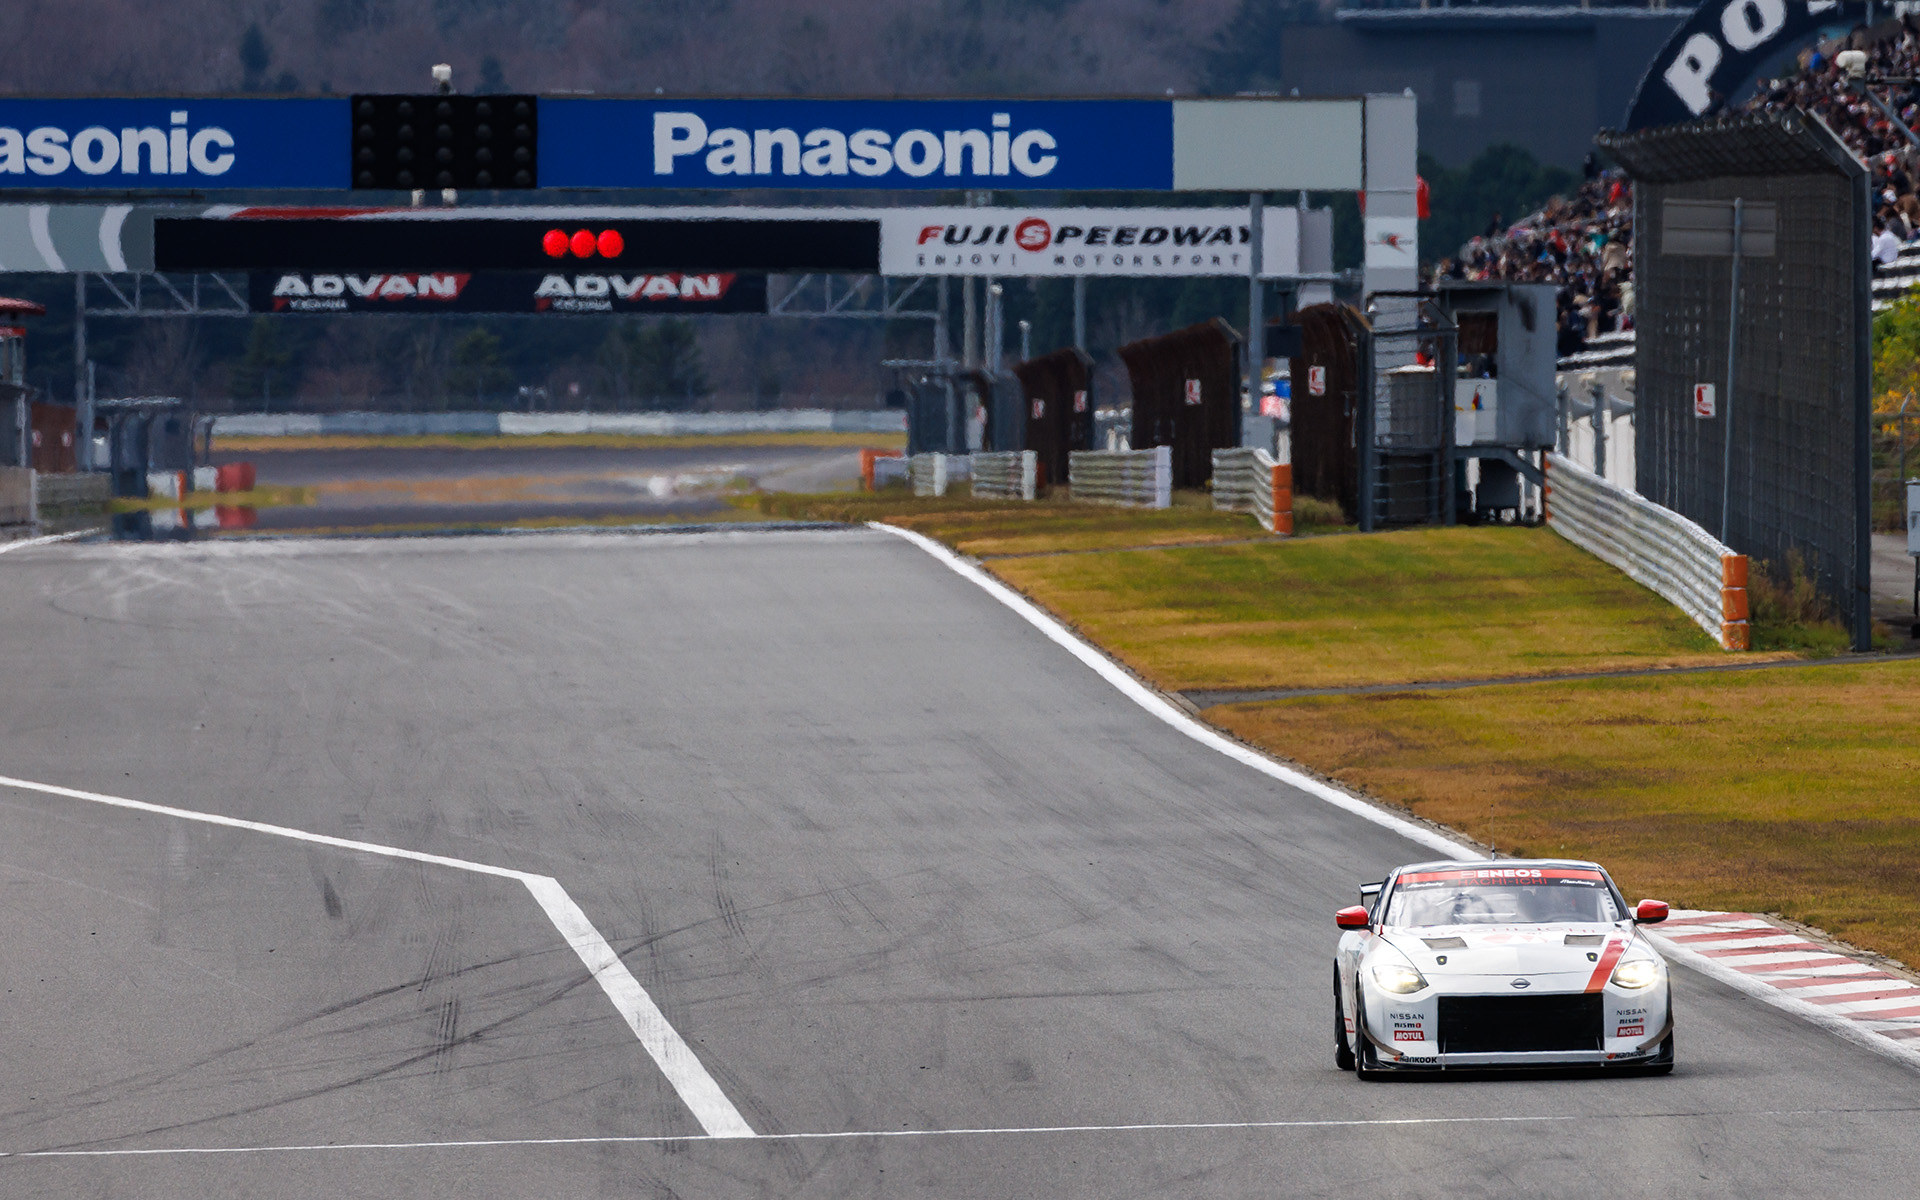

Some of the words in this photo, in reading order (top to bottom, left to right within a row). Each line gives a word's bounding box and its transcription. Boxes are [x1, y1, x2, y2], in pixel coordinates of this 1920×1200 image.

[653, 111, 1058, 177] Panasonic
[917, 225, 1008, 245] FUJI
[272, 274, 459, 297] ADVAN
[534, 274, 722, 298] ADVAN
[1477, 869, 1542, 878] ENEOS
[1457, 877, 1547, 886] HACHI-ICHI
[1616, 1008, 1647, 1016] NISSAN
[1396, 1032, 1422, 1040] MOTUL
[1618, 1027, 1643, 1036] MOTUL
